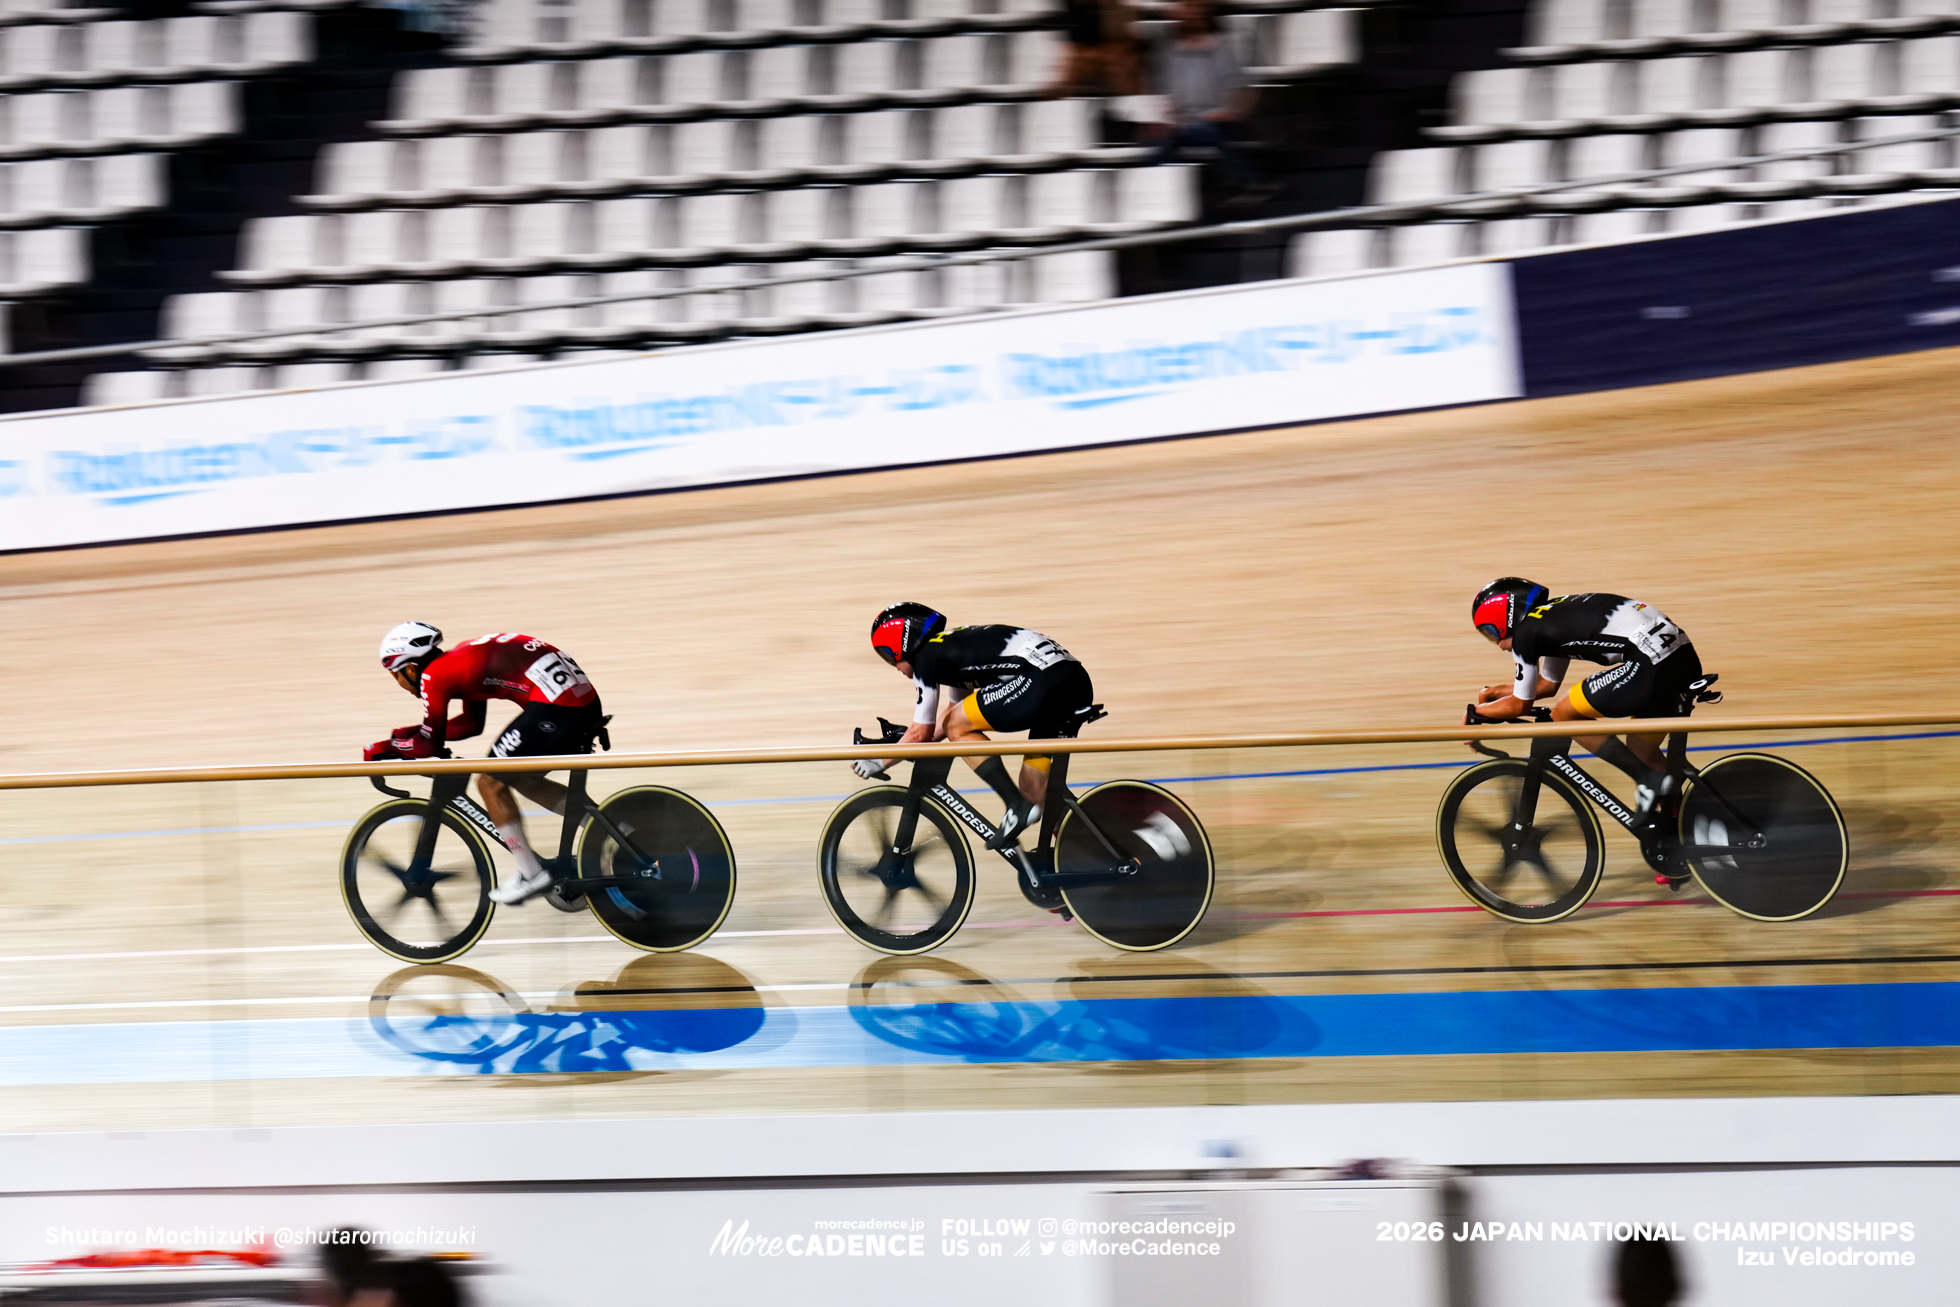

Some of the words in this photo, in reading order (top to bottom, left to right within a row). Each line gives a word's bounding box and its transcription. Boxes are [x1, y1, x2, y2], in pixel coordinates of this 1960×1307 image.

[1561, 640, 1626, 649] ANCHOR
[1647, 621, 1677, 650] 14
[544, 660, 572, 686] 16
[960, 663, 1021, 671] ANCHOR
[1612, 662, 1641, 692] ANCHOR
[1003, 678, 1033, 706] ANCHOR
